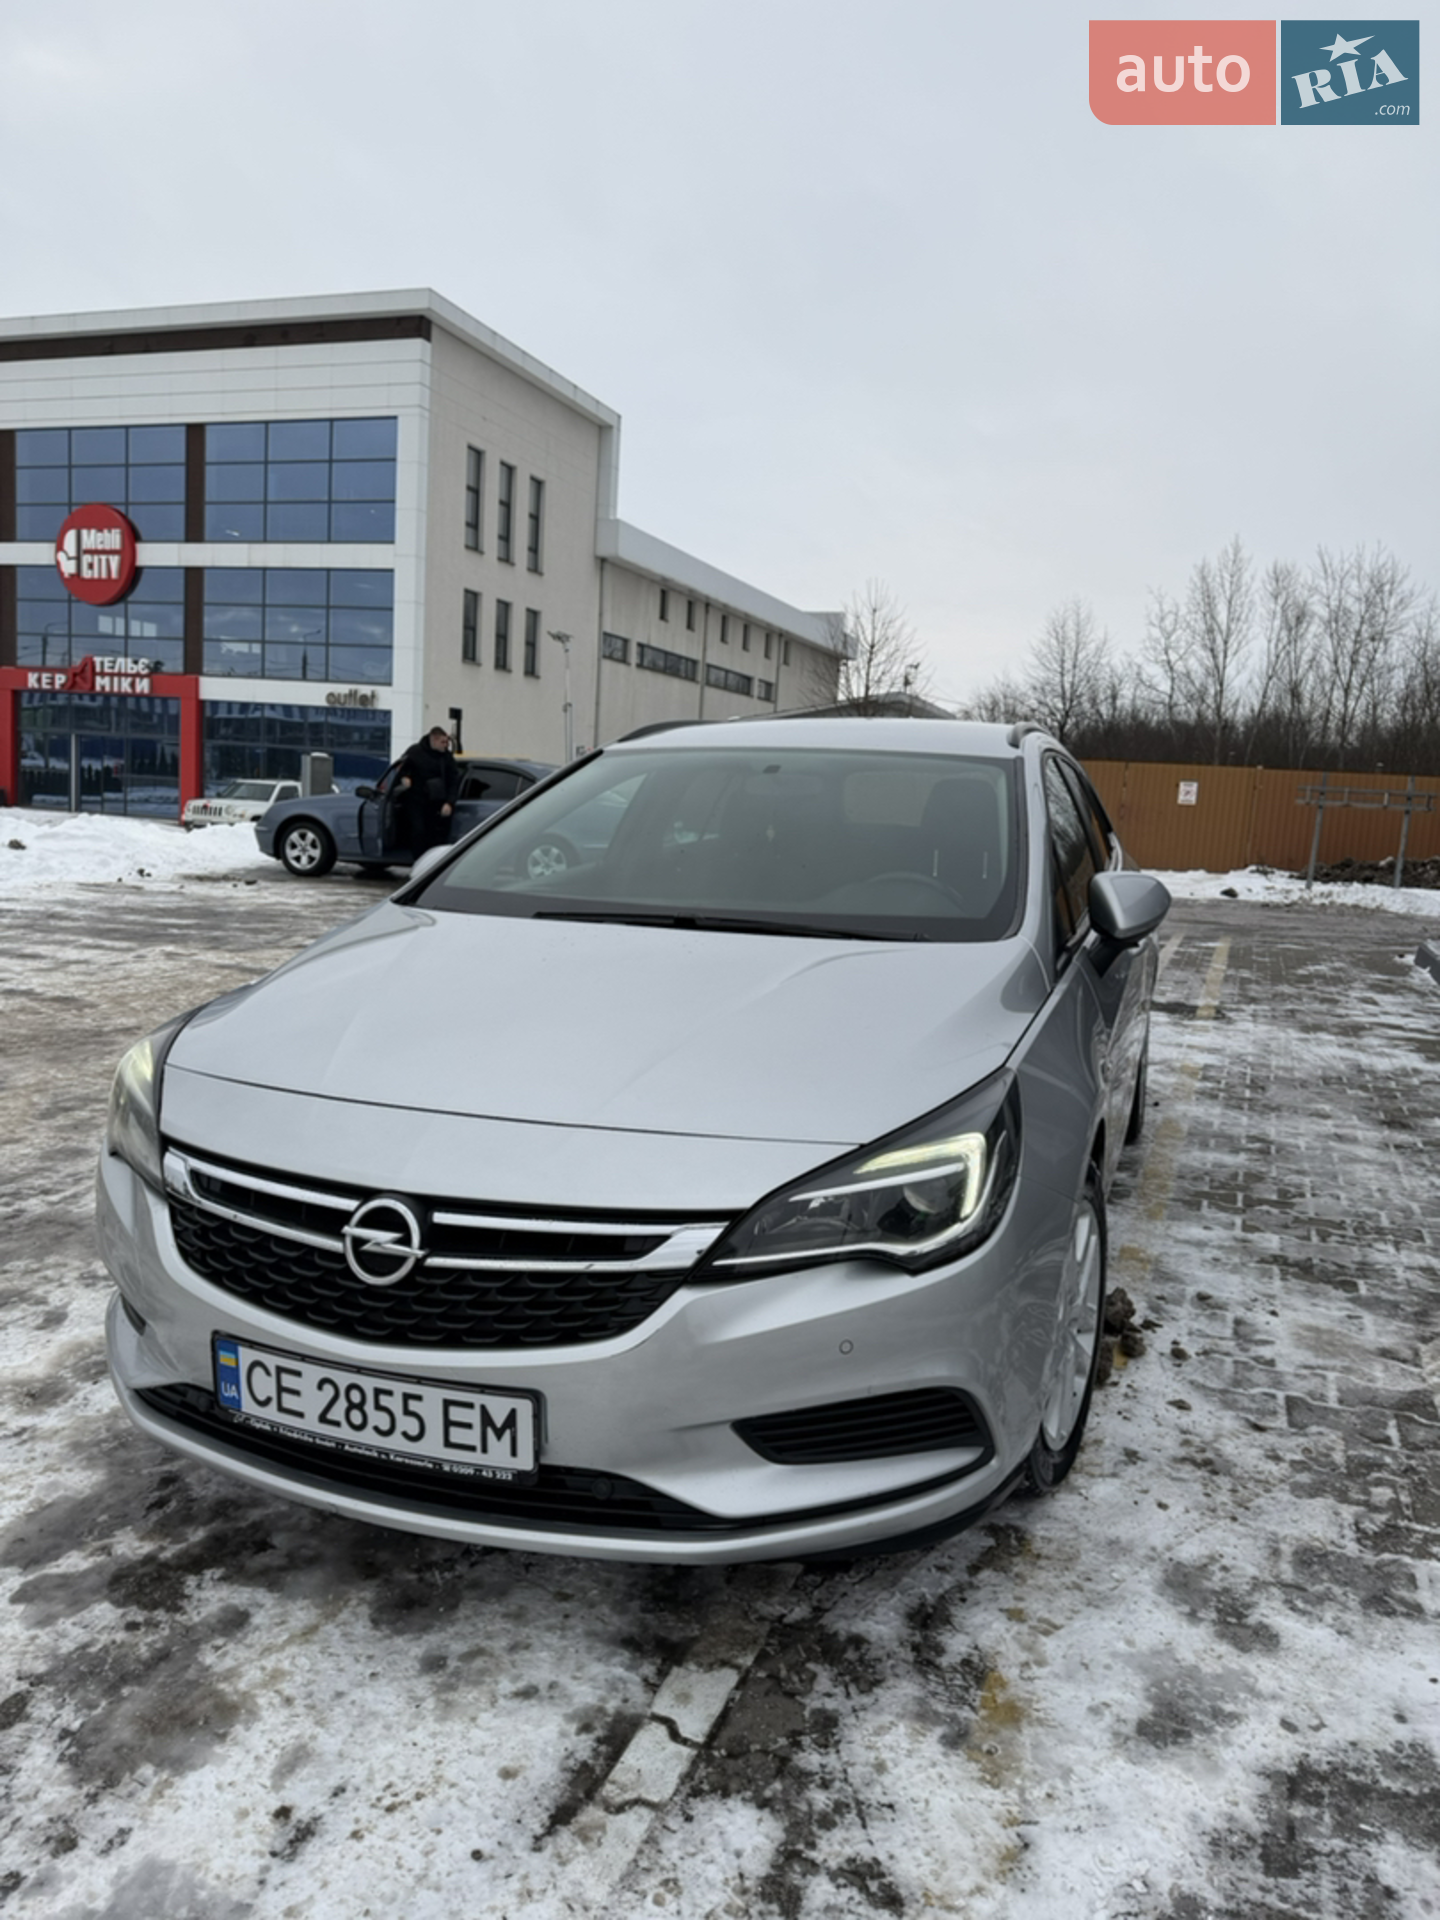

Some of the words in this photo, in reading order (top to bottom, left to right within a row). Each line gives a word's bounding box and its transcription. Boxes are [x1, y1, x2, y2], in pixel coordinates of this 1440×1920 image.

[81, 554, 122, 580] CITY
[325, 688, 378, 707] outlet
[221, 1381, 239, 1400] UA
[246, 1360, 305, 1419] CE
[316, 1377, 426, 1442] 2855
[442, 1398, 518, 1458] EM
